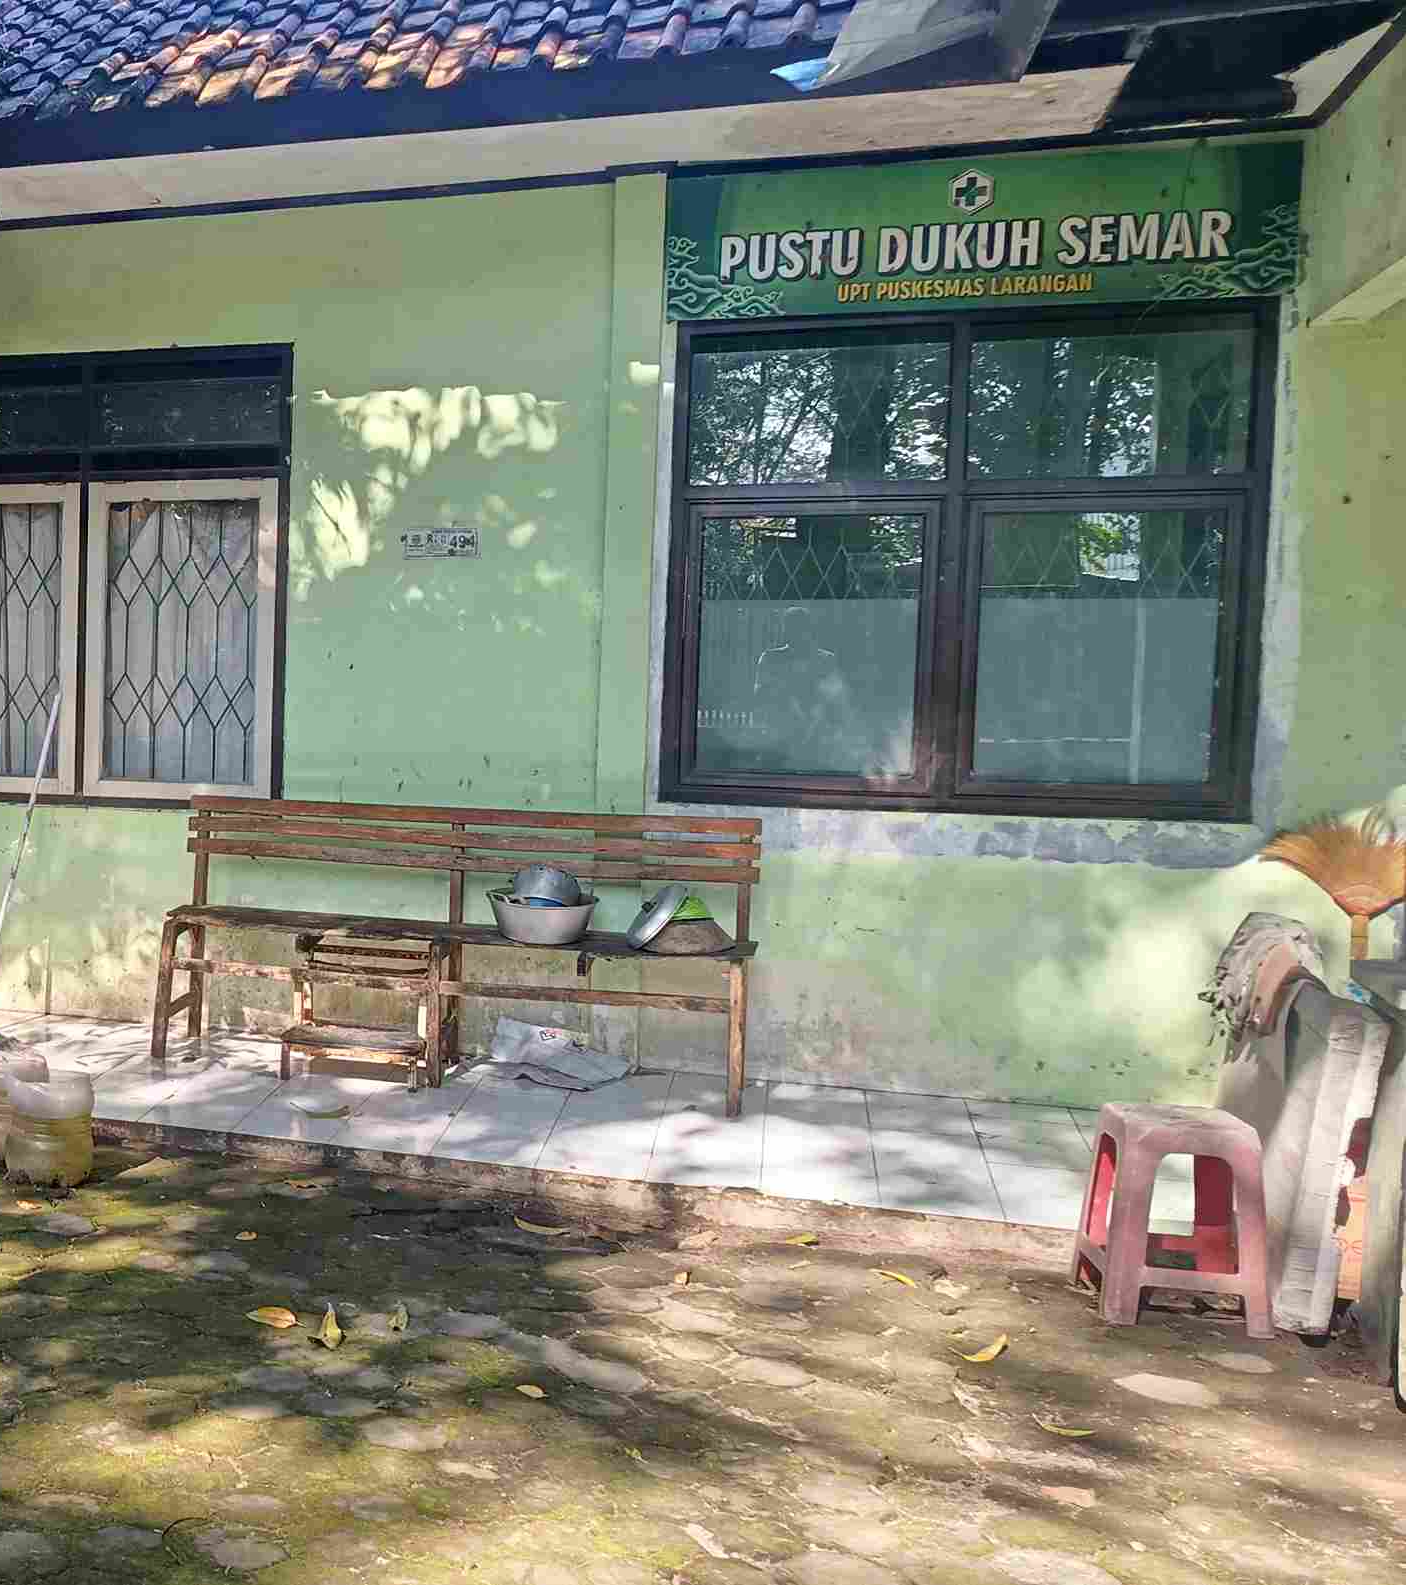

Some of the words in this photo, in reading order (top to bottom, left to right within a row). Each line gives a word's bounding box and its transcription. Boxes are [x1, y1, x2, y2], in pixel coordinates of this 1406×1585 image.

[720, 229, 861, 281] PUSTU
[878, 219, 1042, 273] DUKUH
[1057, 210, 1233, 265] SEMAR
[837, 282, 871, 302] UPT
[876, 277, 985, 301] PUSKESMAS
[991, 271, 1093, 297] LARANGAN
